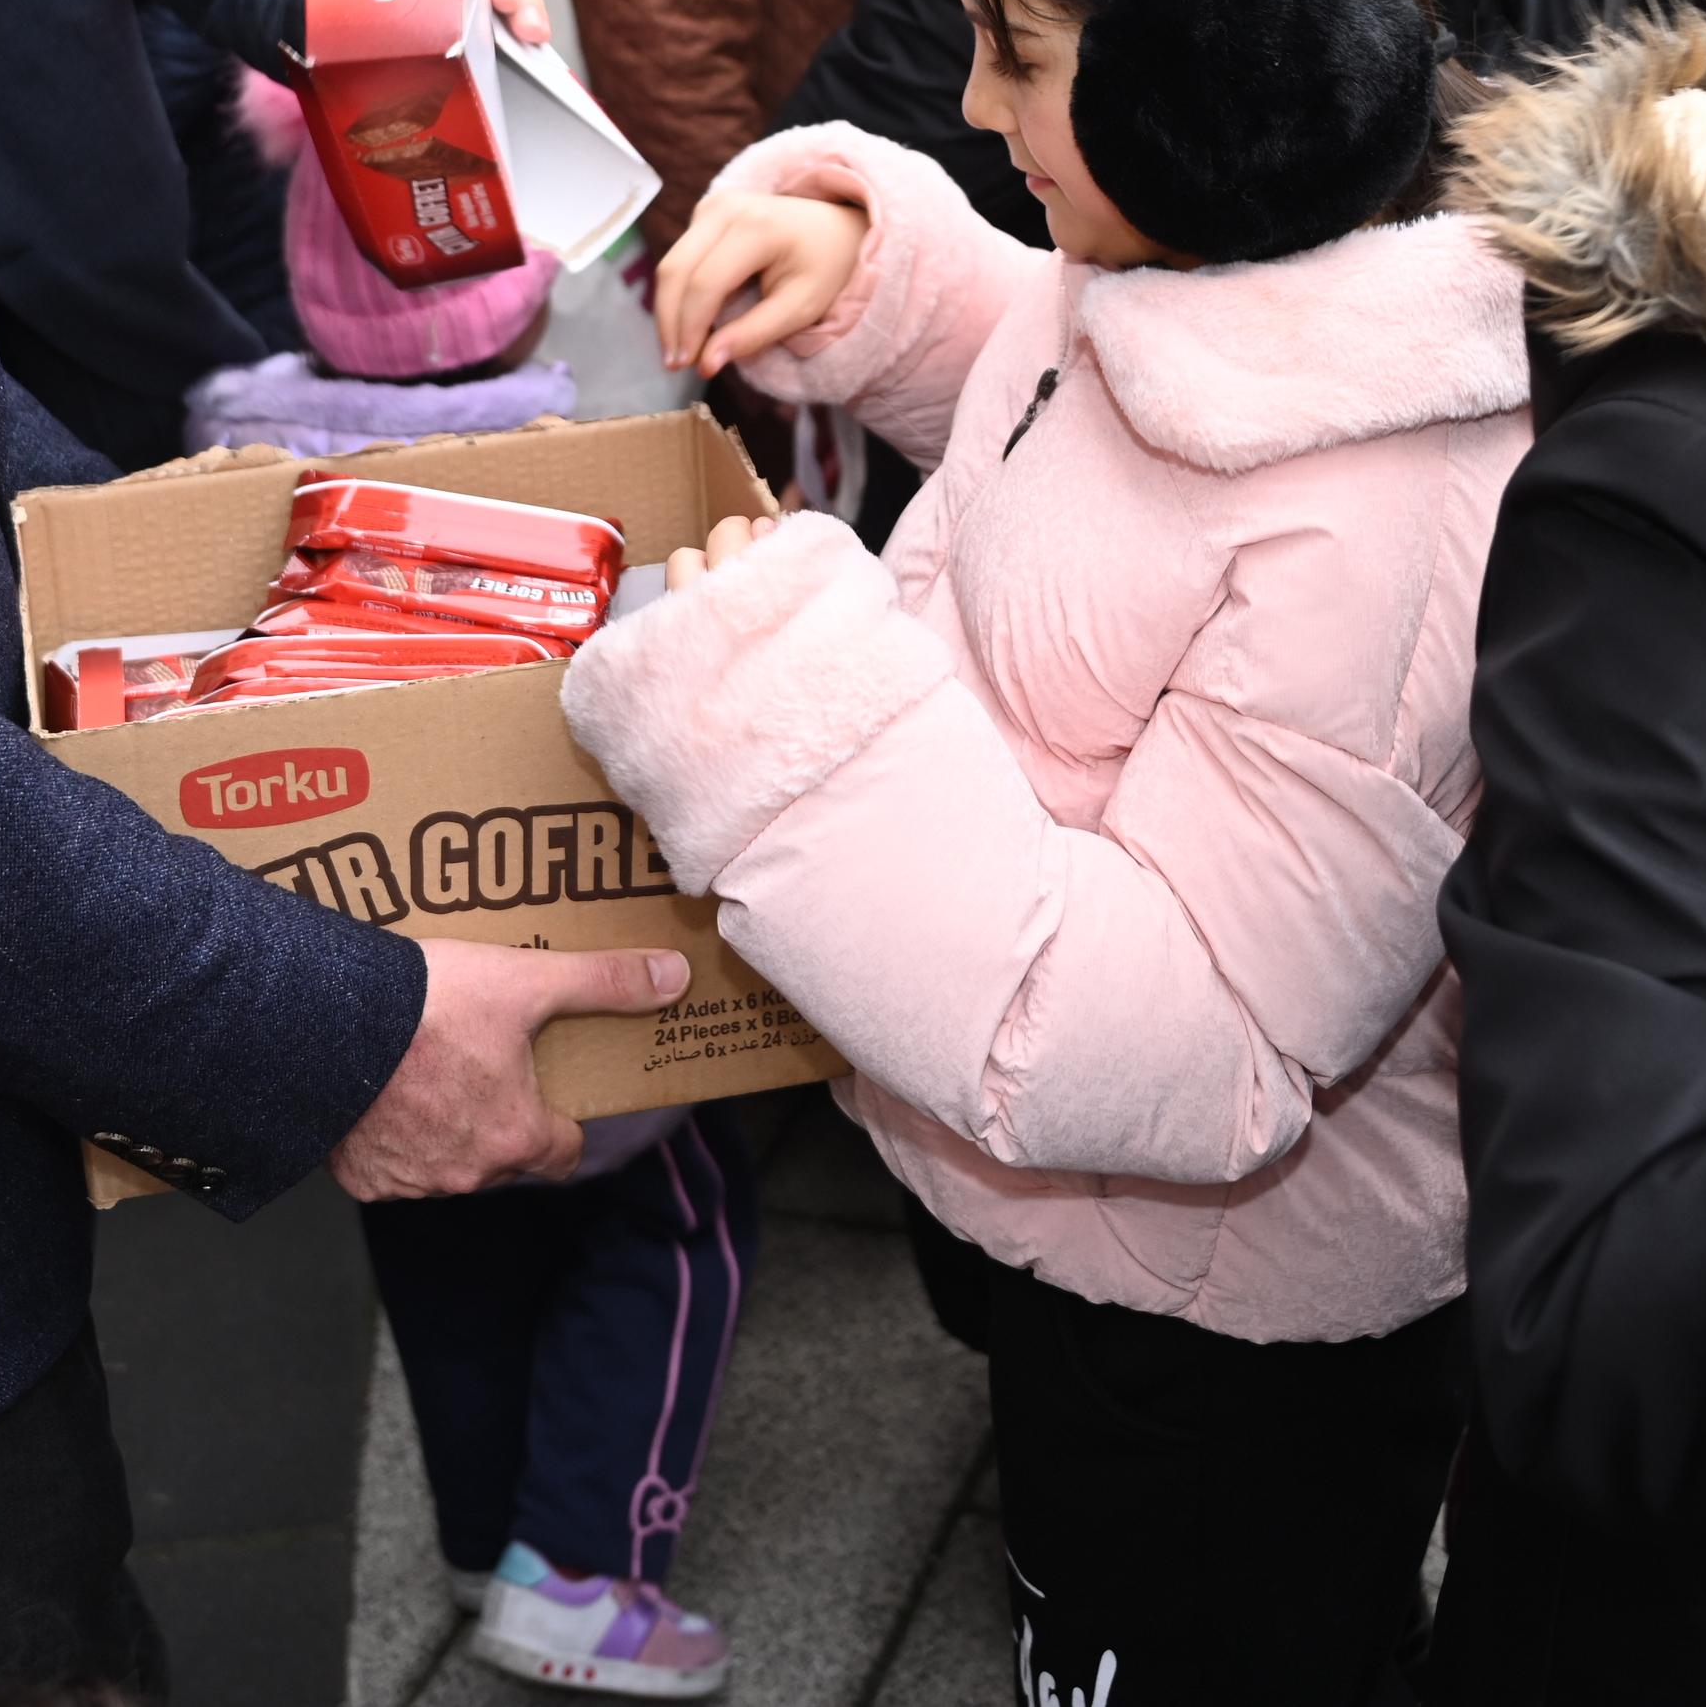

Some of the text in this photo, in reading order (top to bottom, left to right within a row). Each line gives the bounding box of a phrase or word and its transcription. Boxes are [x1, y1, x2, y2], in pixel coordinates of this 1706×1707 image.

[469, 576, 544, 601] GOFRET
[196, 760, 349, 816] Torku
[412, 804, 673, 912] GOFRE
[658, 990, 788, 1025] 24 Adet x 6 Ku
[655, 1009, 806, 1046] 24 Pieces x 6 Bo
[644, 1046, 702, 1072] صناديق
